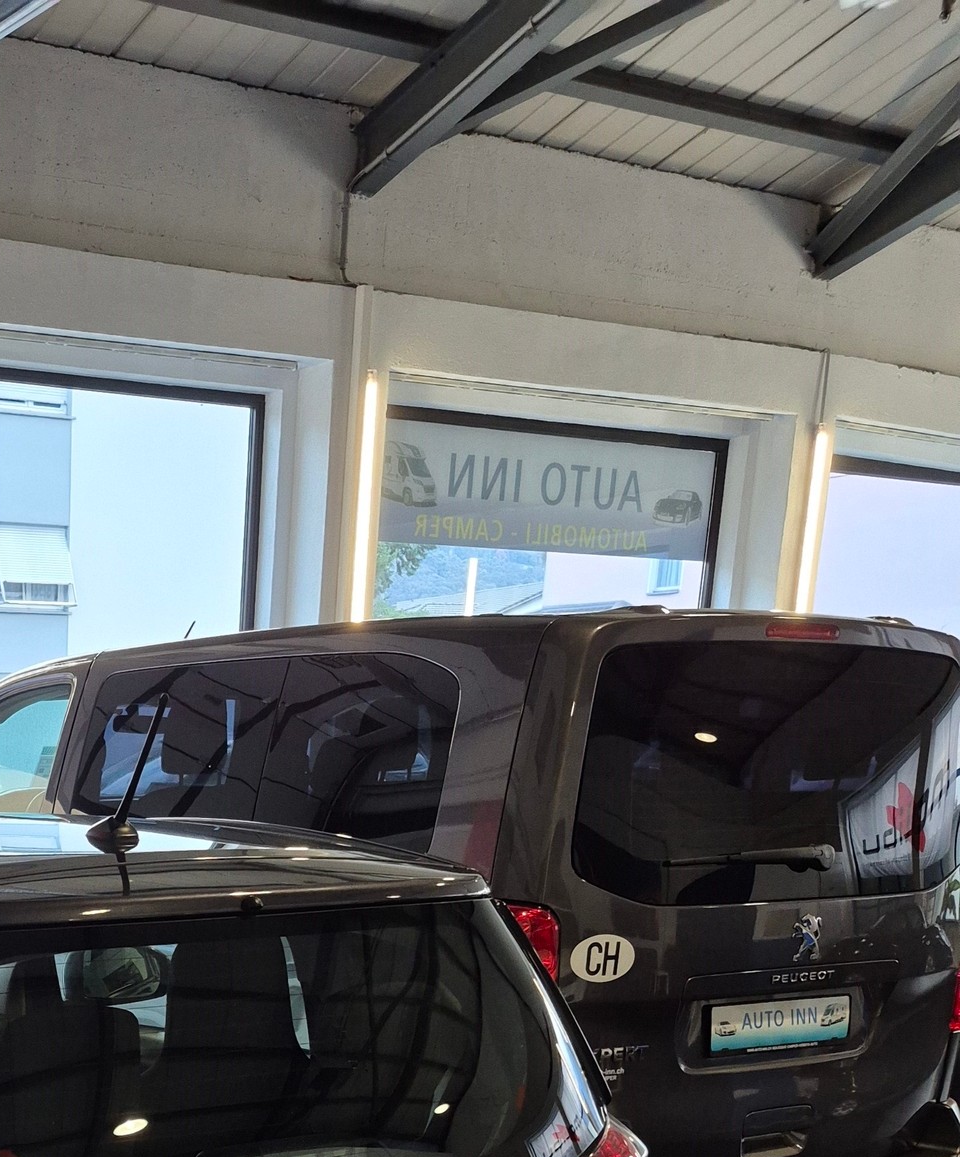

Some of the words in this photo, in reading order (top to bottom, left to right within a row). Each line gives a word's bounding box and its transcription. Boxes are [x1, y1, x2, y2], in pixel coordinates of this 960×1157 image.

[585, 941, 621, 976] CH
[772, 969, 836, 984] PEUGEOT
[741, 1009, 784, 1030] AUTO
[790, 1006, 818, 1025] INN
